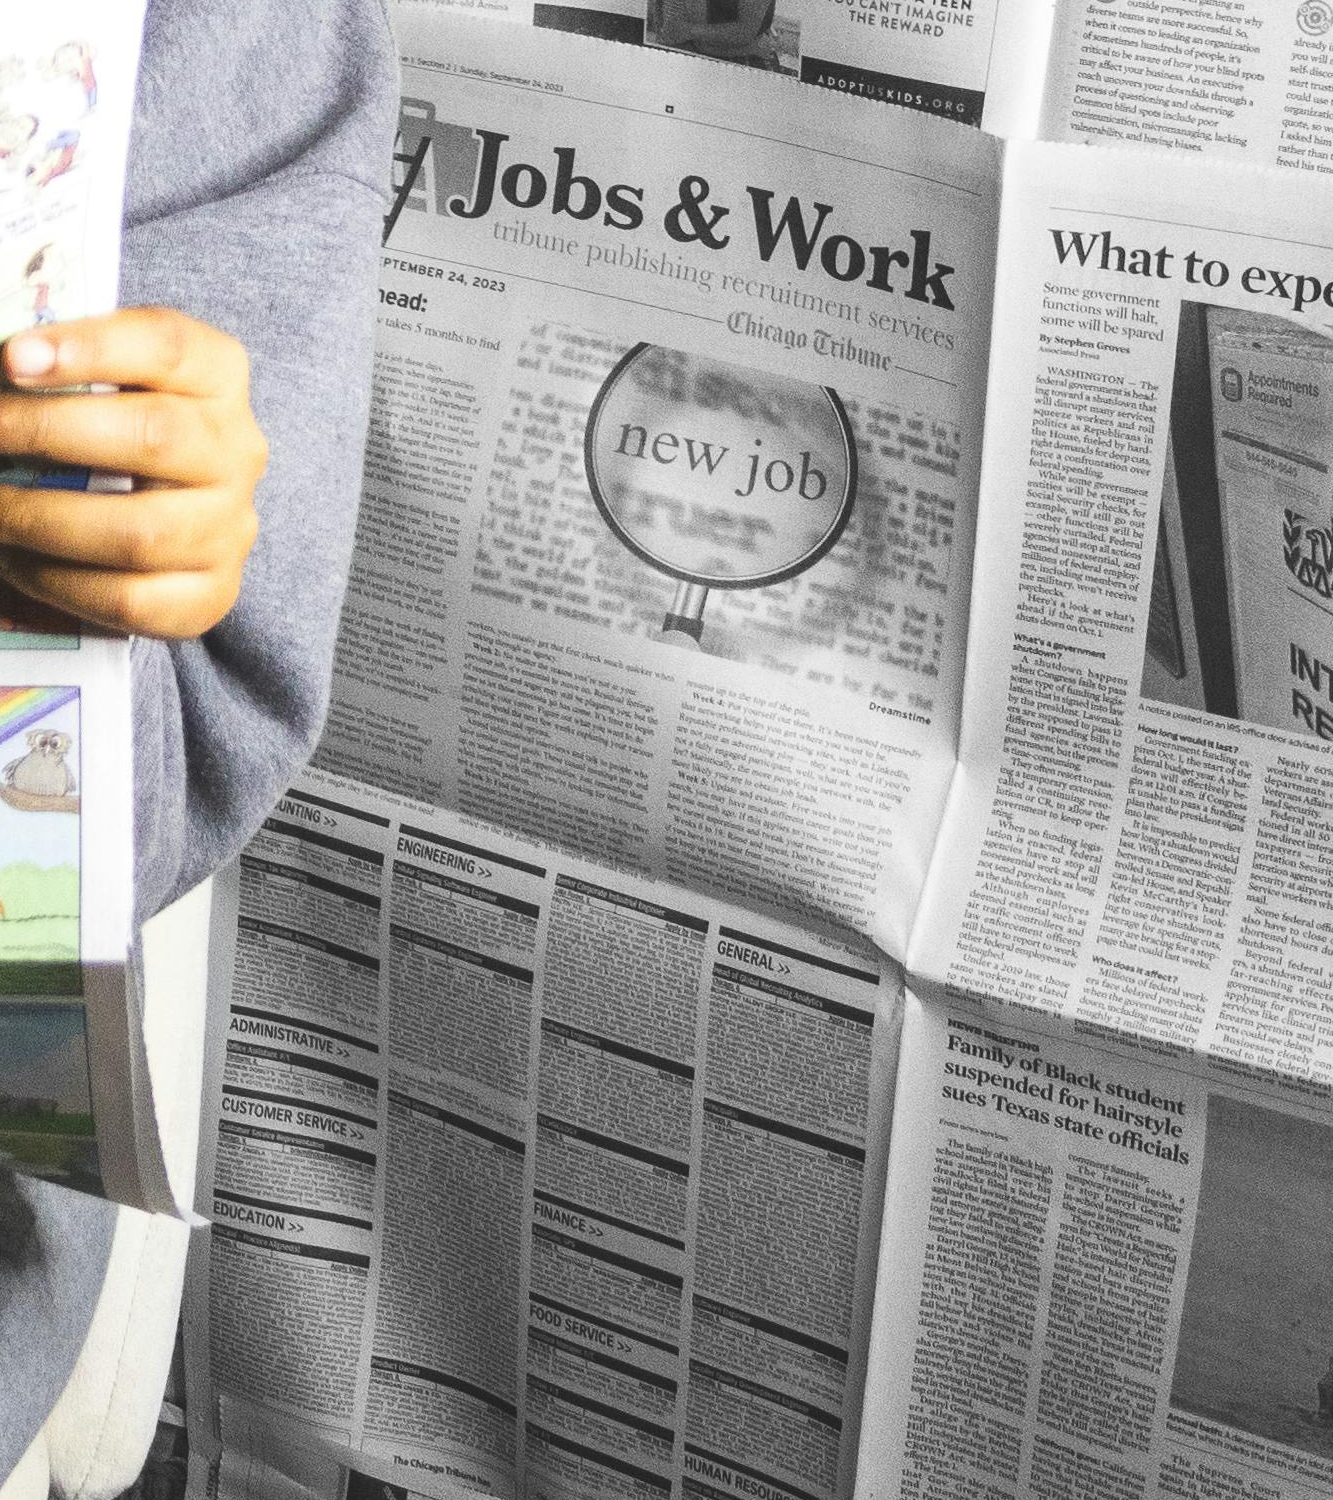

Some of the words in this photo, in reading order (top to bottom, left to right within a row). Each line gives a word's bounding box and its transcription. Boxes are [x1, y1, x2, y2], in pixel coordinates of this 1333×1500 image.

[450, 131, 644, 230] Jobs
[664, 175, 728, 250] &
[748, 187, 956, 312] Work
[1051, 229, 1173, 279] What
[1185, 252, 1229, 286] to
[613, 410, 728, 474] new
[735, 438, 834, 501] job
